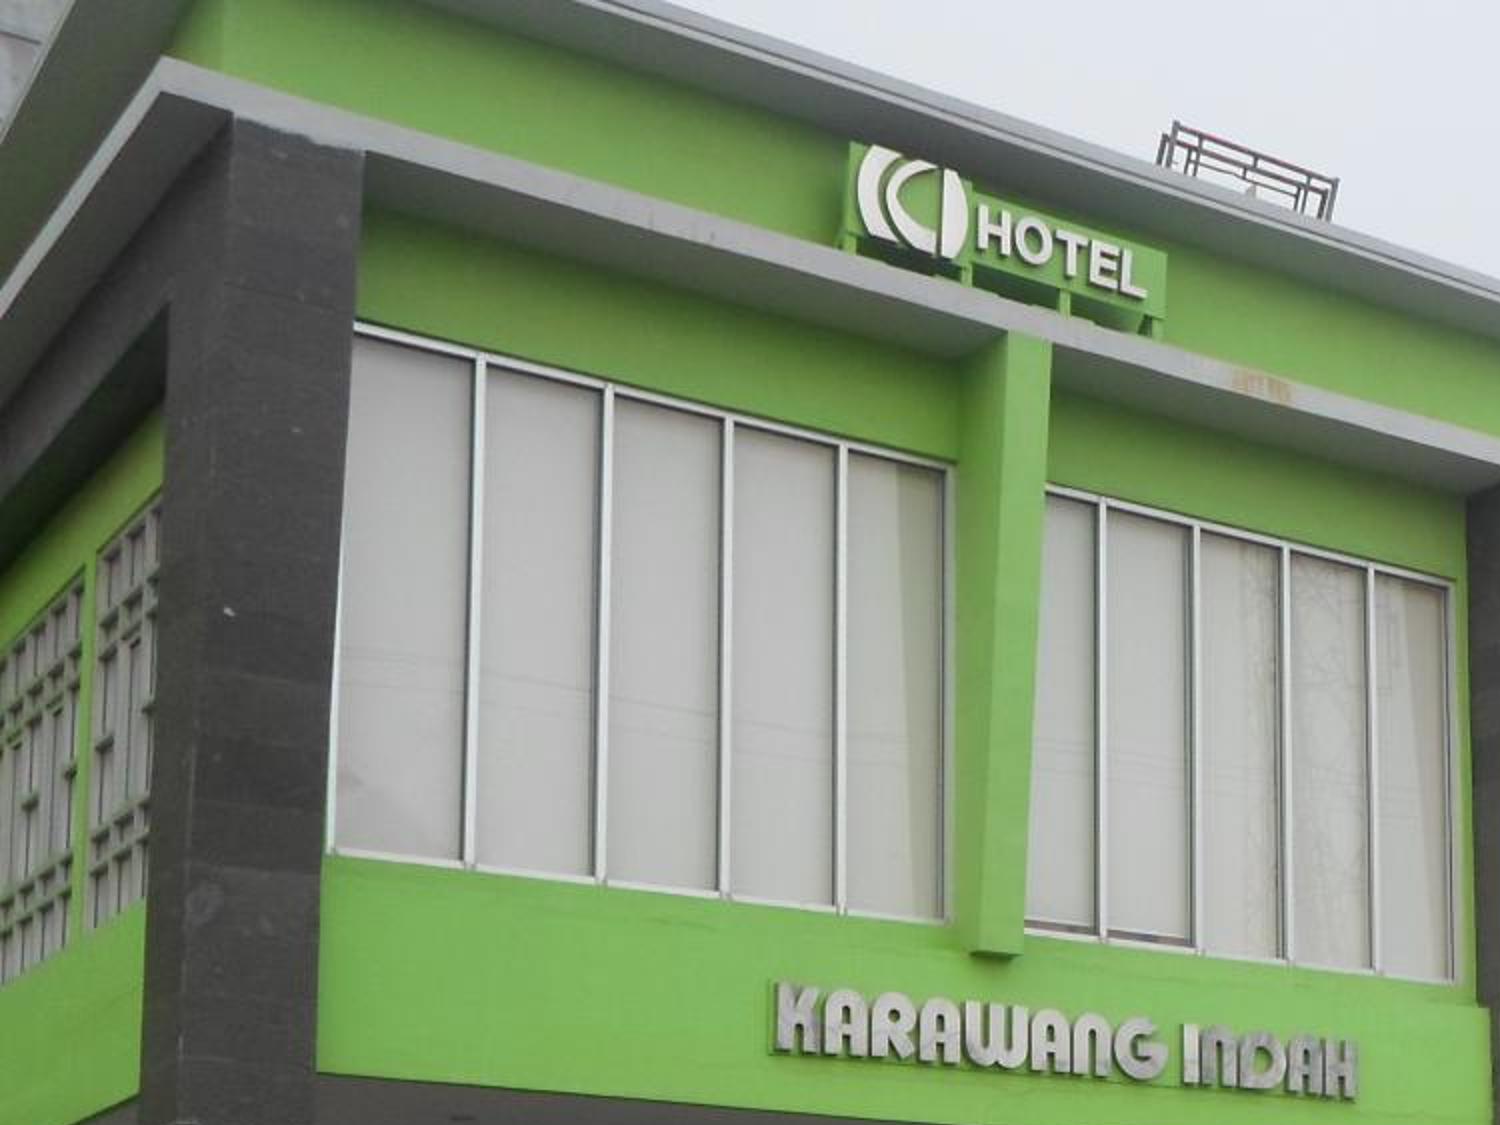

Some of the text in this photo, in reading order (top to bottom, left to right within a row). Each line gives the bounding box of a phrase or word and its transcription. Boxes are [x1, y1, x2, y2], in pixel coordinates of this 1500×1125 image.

[976, 203, 1148, 300] HOTEL
[774, 981, 1358, 1101] KARAWANG INDAH
